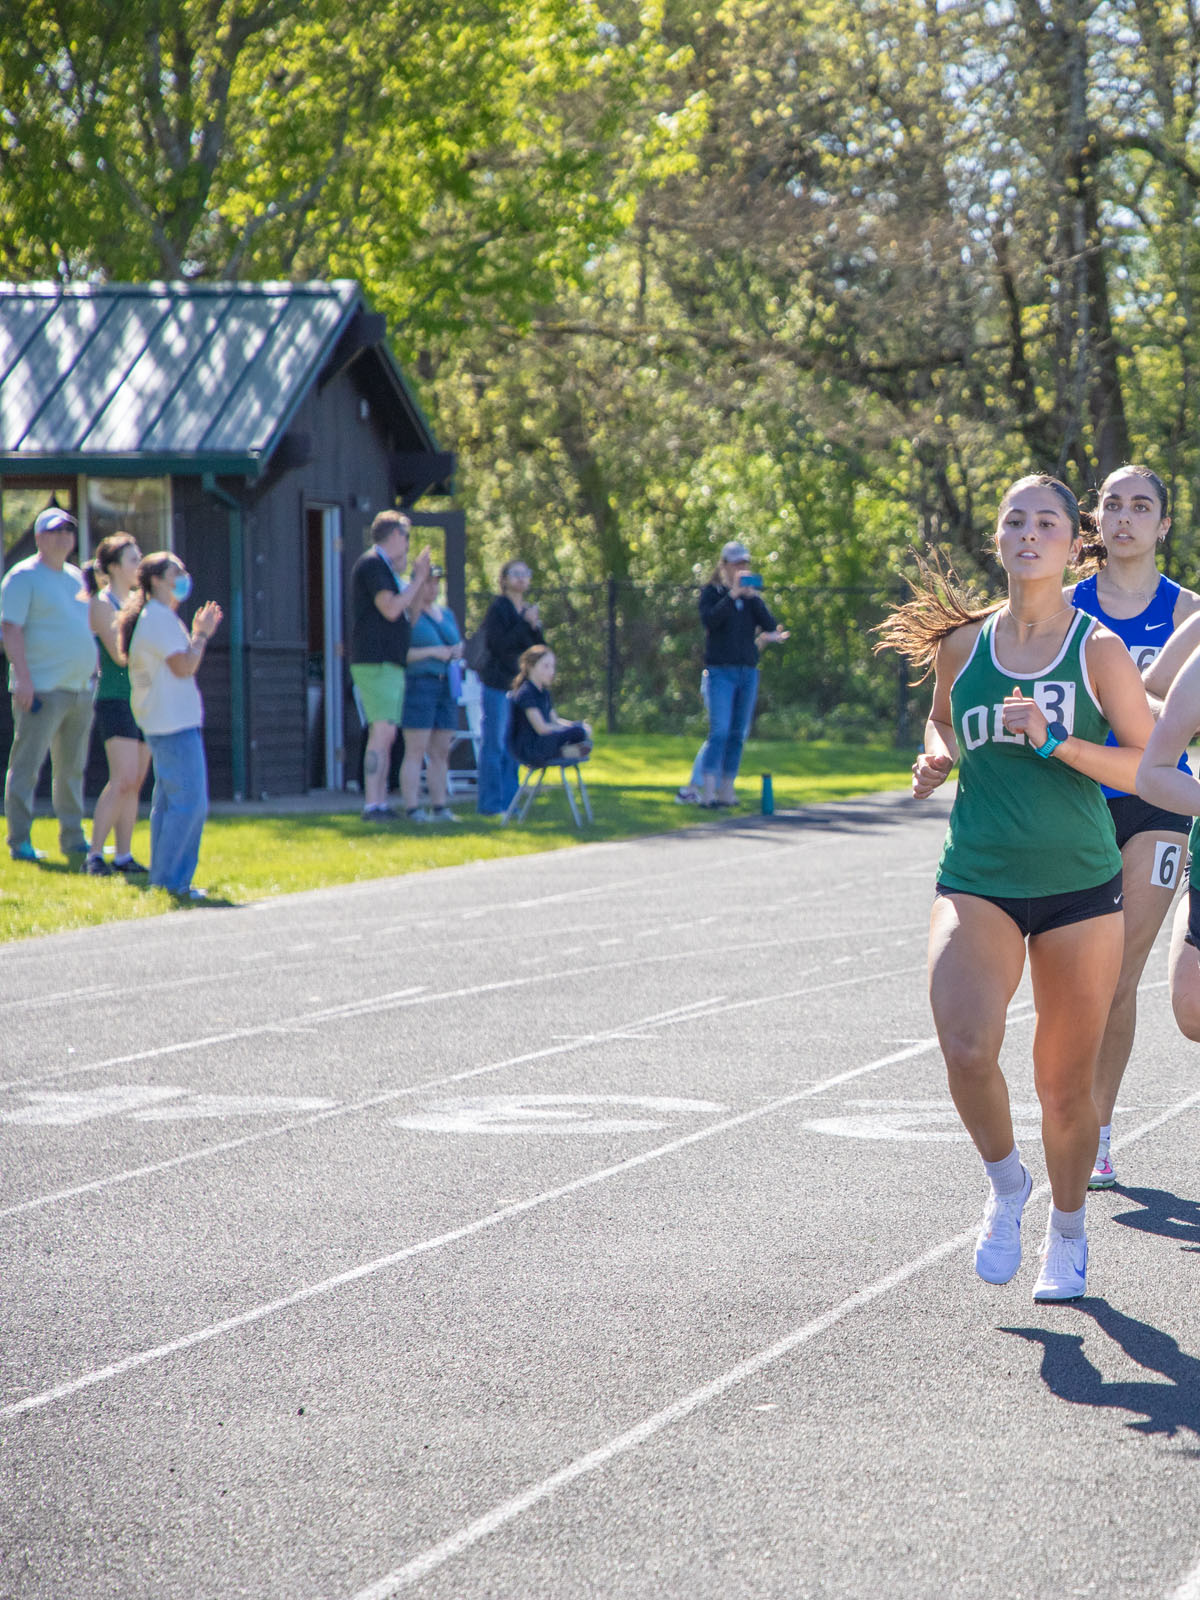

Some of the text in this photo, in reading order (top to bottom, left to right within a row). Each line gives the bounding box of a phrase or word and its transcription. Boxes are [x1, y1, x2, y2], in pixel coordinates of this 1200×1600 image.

[1137, 648, 1156, 674] 6
[1043, 684, 1066, 725] 3
[1159, 845, 1177, 885] 6
